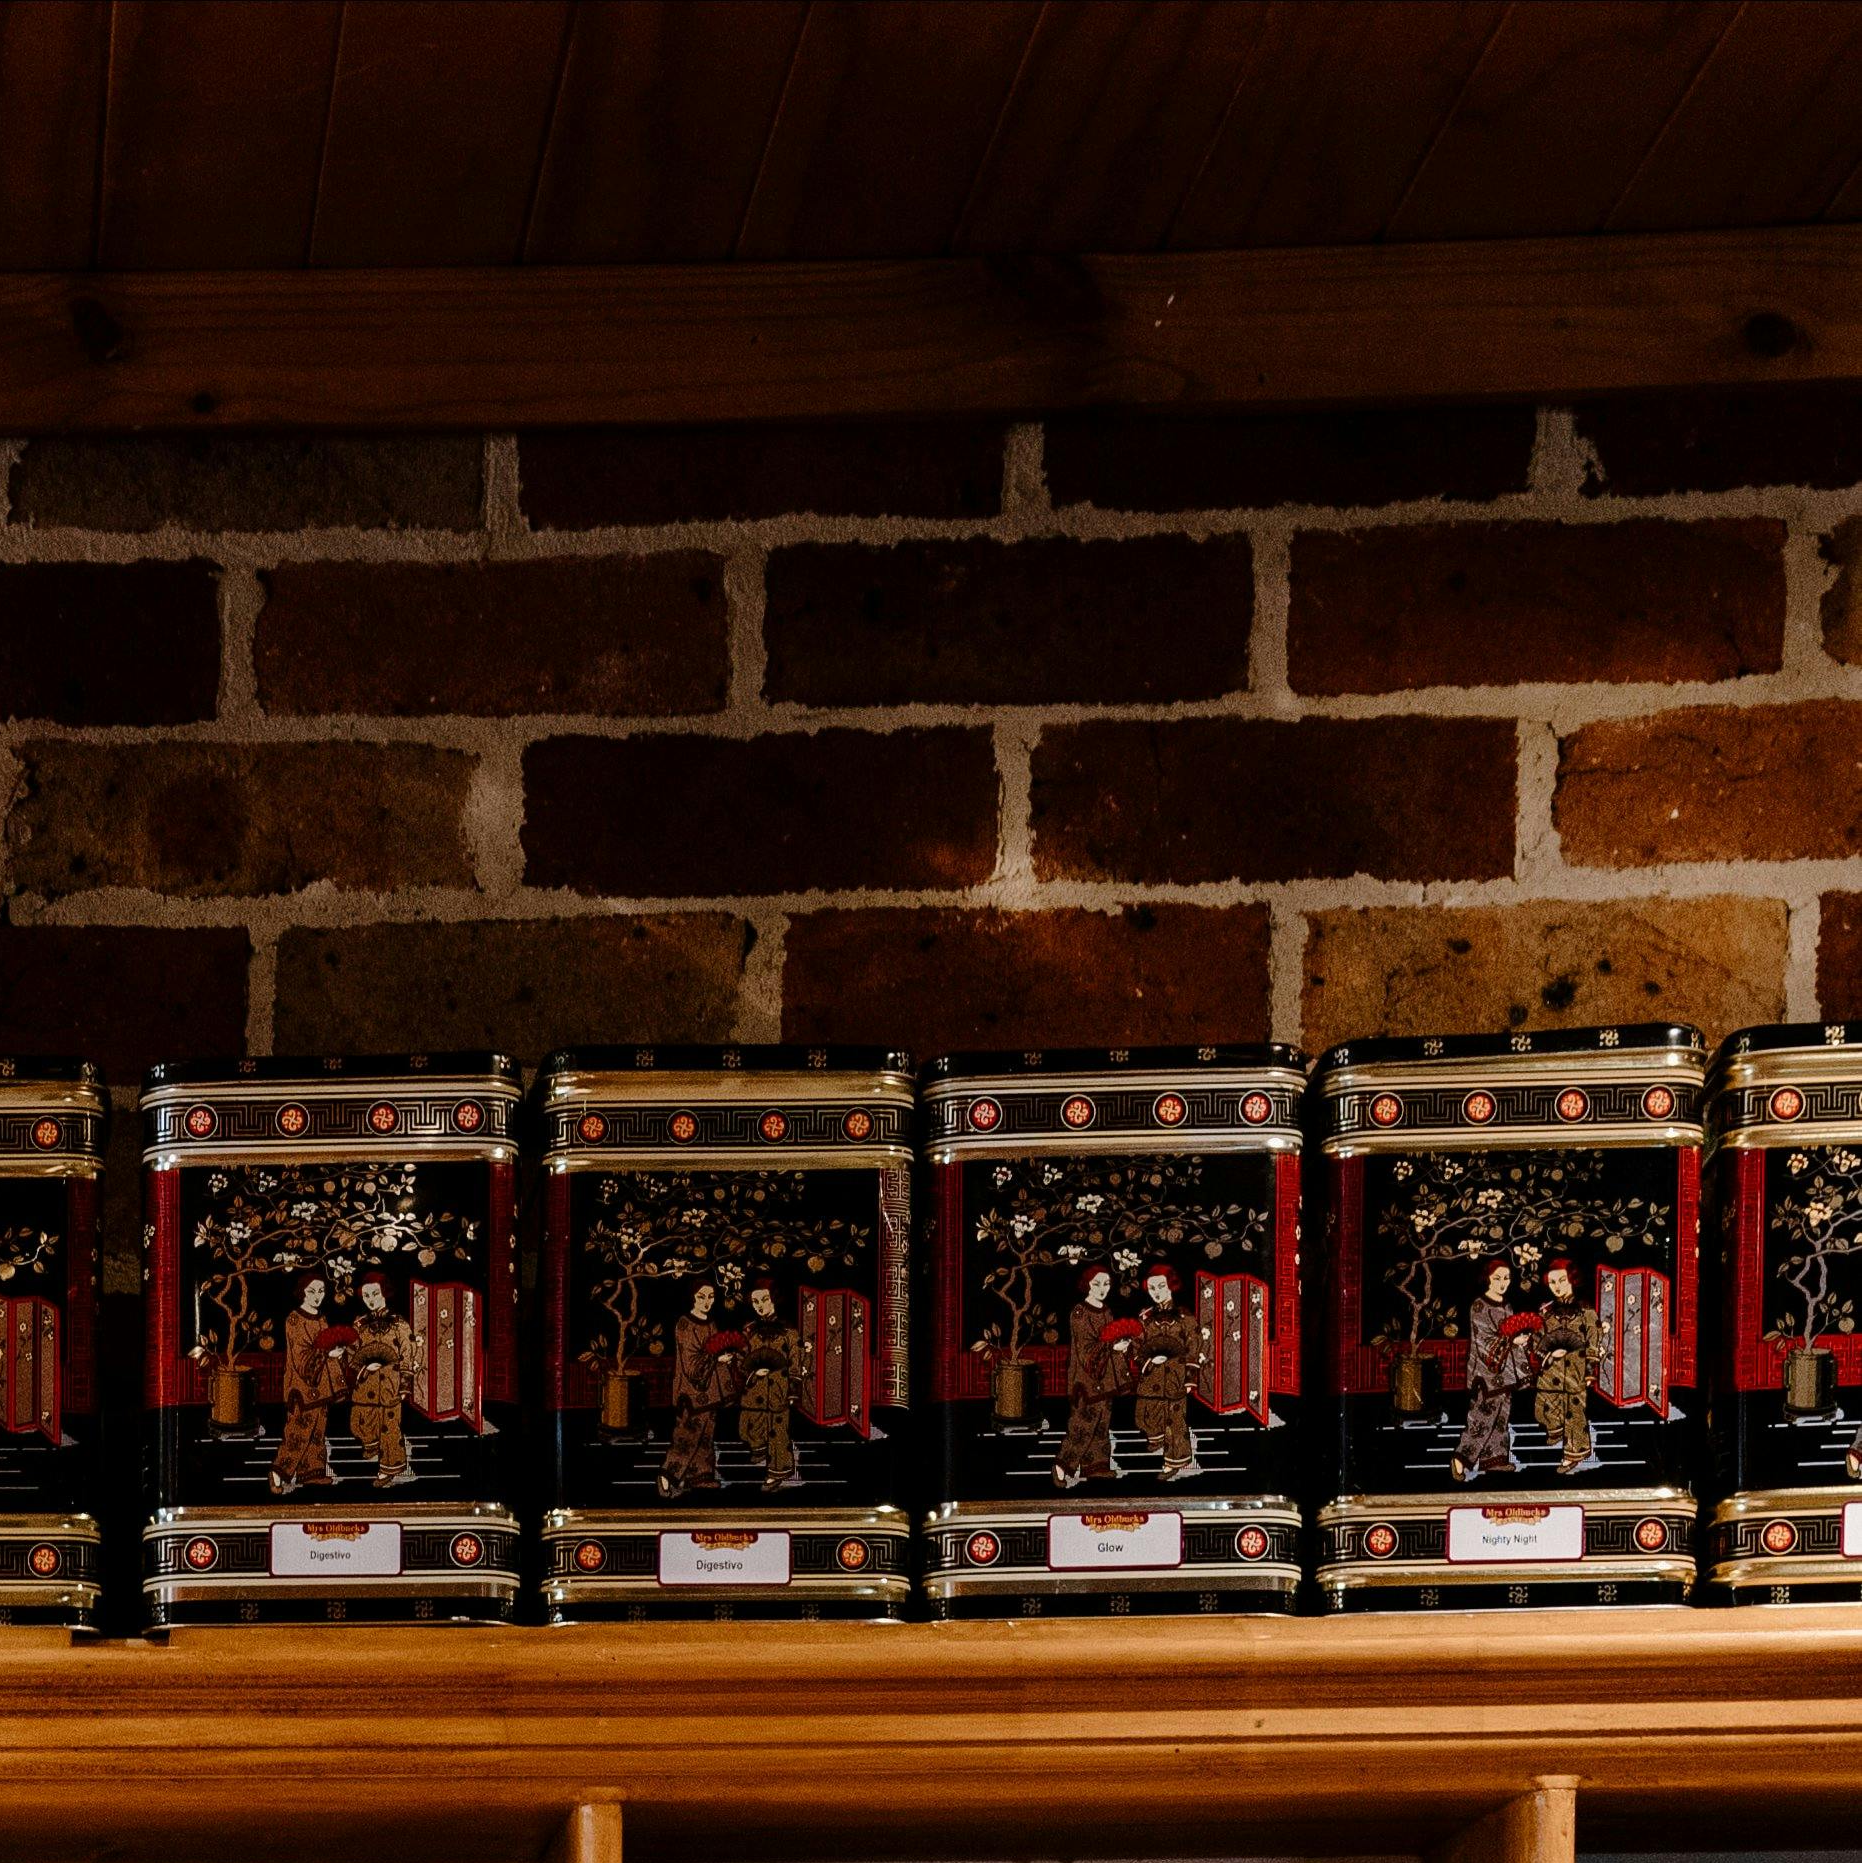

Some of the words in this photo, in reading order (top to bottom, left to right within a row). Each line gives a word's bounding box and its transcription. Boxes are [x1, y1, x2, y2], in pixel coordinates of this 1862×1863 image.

[1486, 1507, 1501, 1517] Mrs
[1505, 1508, 1545, 1516] Oldbucks
[1483, 1535, 1510, 1545] Nighty
[1514, 1535, 1536, 1545] Night
[1098, 1543, 1123, 1552] Glow
[311, 1551, 350, 1561] Digestivo
[697, 1560, 742, 1572] Digestivo
